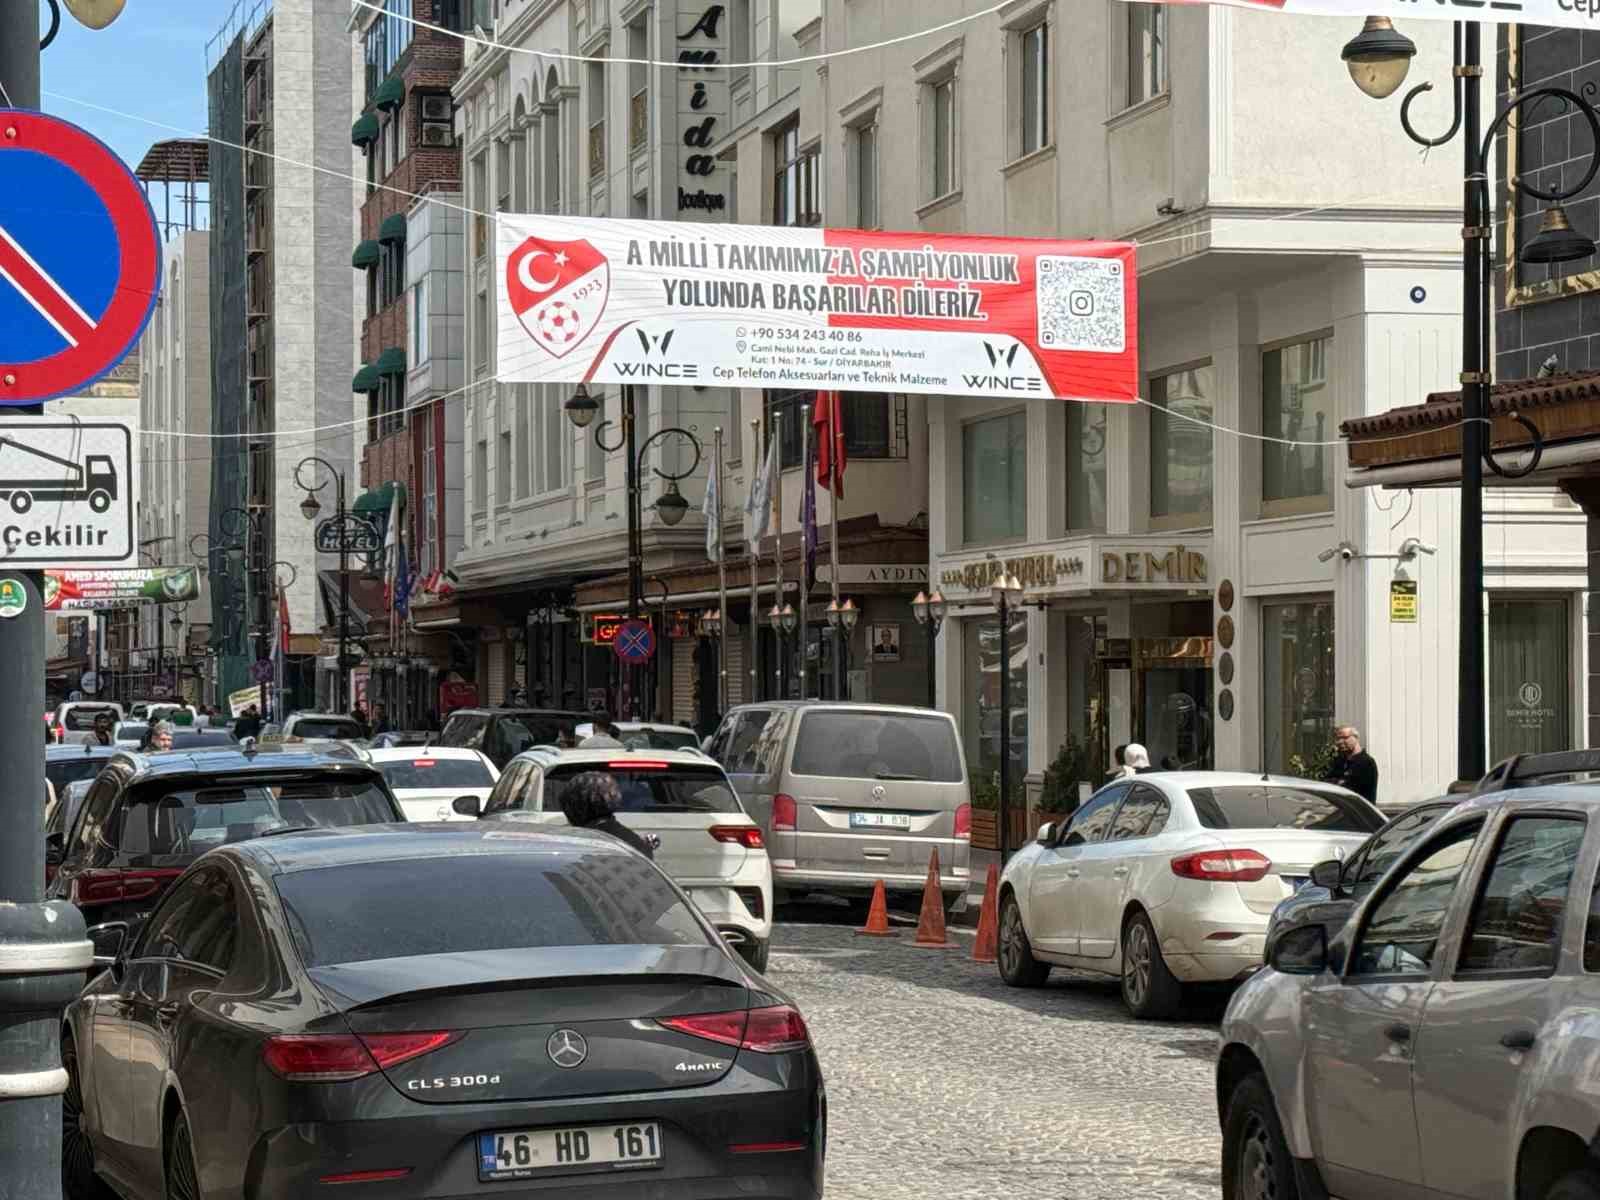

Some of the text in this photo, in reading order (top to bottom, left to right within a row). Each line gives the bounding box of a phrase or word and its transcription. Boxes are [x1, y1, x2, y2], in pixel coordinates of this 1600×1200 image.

[676, 5, 726, 177] Amida
[626, 239, 643, 266] A
[649, 235, 708, 269] MİLLİ
[862, 246, 1018, 282] ŞAMPİYONLUK
[572, 279, 603, 300] 1923
[662, 278, 987, 320] YOLUNDA BAŞARILAR DİLERİZ.
[751, 327, 863, 343] +90 534 243 40 86
[613, 362, 698, 378] WINCE
[712, 365, 948, 386] Cep Telefon Aksesuarları ve Teknik Malzeme
[962, 374, 1042, 391] WINCE
[2, 524, 109, 553] Çekilir
[865, 567, 929, 581] AYDIN
[1102, 544, 1208, 583] DEMİR
[674, 1061, 723, 1073] 4MATIC
[407, 1077, 446, 1090] CLS
[497, 1125, 657, 1167] 46 HD 161
